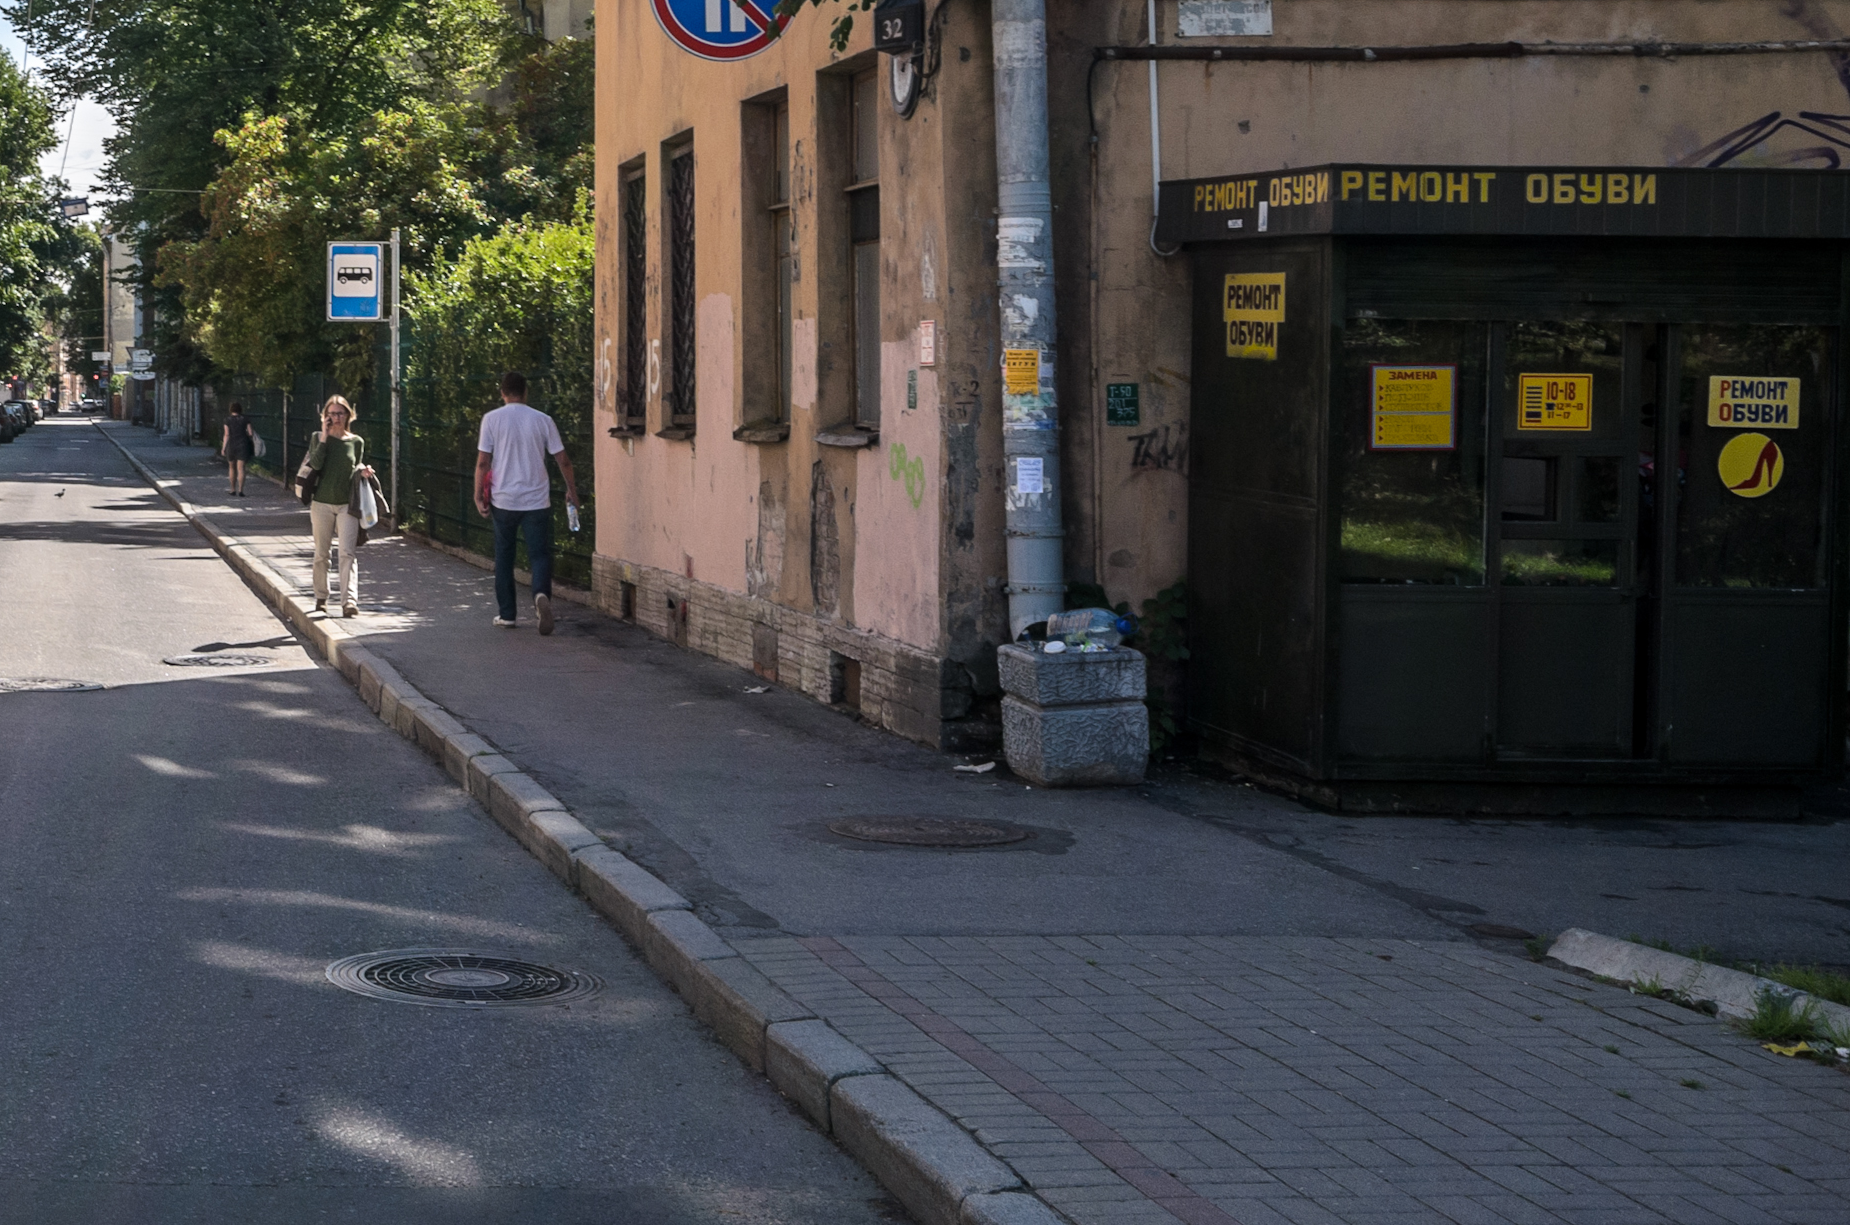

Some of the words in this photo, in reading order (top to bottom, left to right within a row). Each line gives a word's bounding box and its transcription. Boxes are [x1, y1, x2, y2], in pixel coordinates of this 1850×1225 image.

[882, 18, 903, 40] 32
[1194, 179, 1259, 212] РЕМОНТ
[1269, 172, 1330, 208] ОБУВИ
[1340, 171, 1497, 203] РЕМОНТ
[1525, 173, 1657, 205] ОБУВИ
[1227, 284, 1282, 311] РЕМОНТ
[1229, 320, 1275, 348] ОБУВИ
[1388, 371, 1438, 380] ЗАМЕНА
[1546, 381, 1576, 401] 10-18
[1720, 380, 1788, 400] РЕМОНТ
[1719, 403, 1788, 424] ОБУВИ
